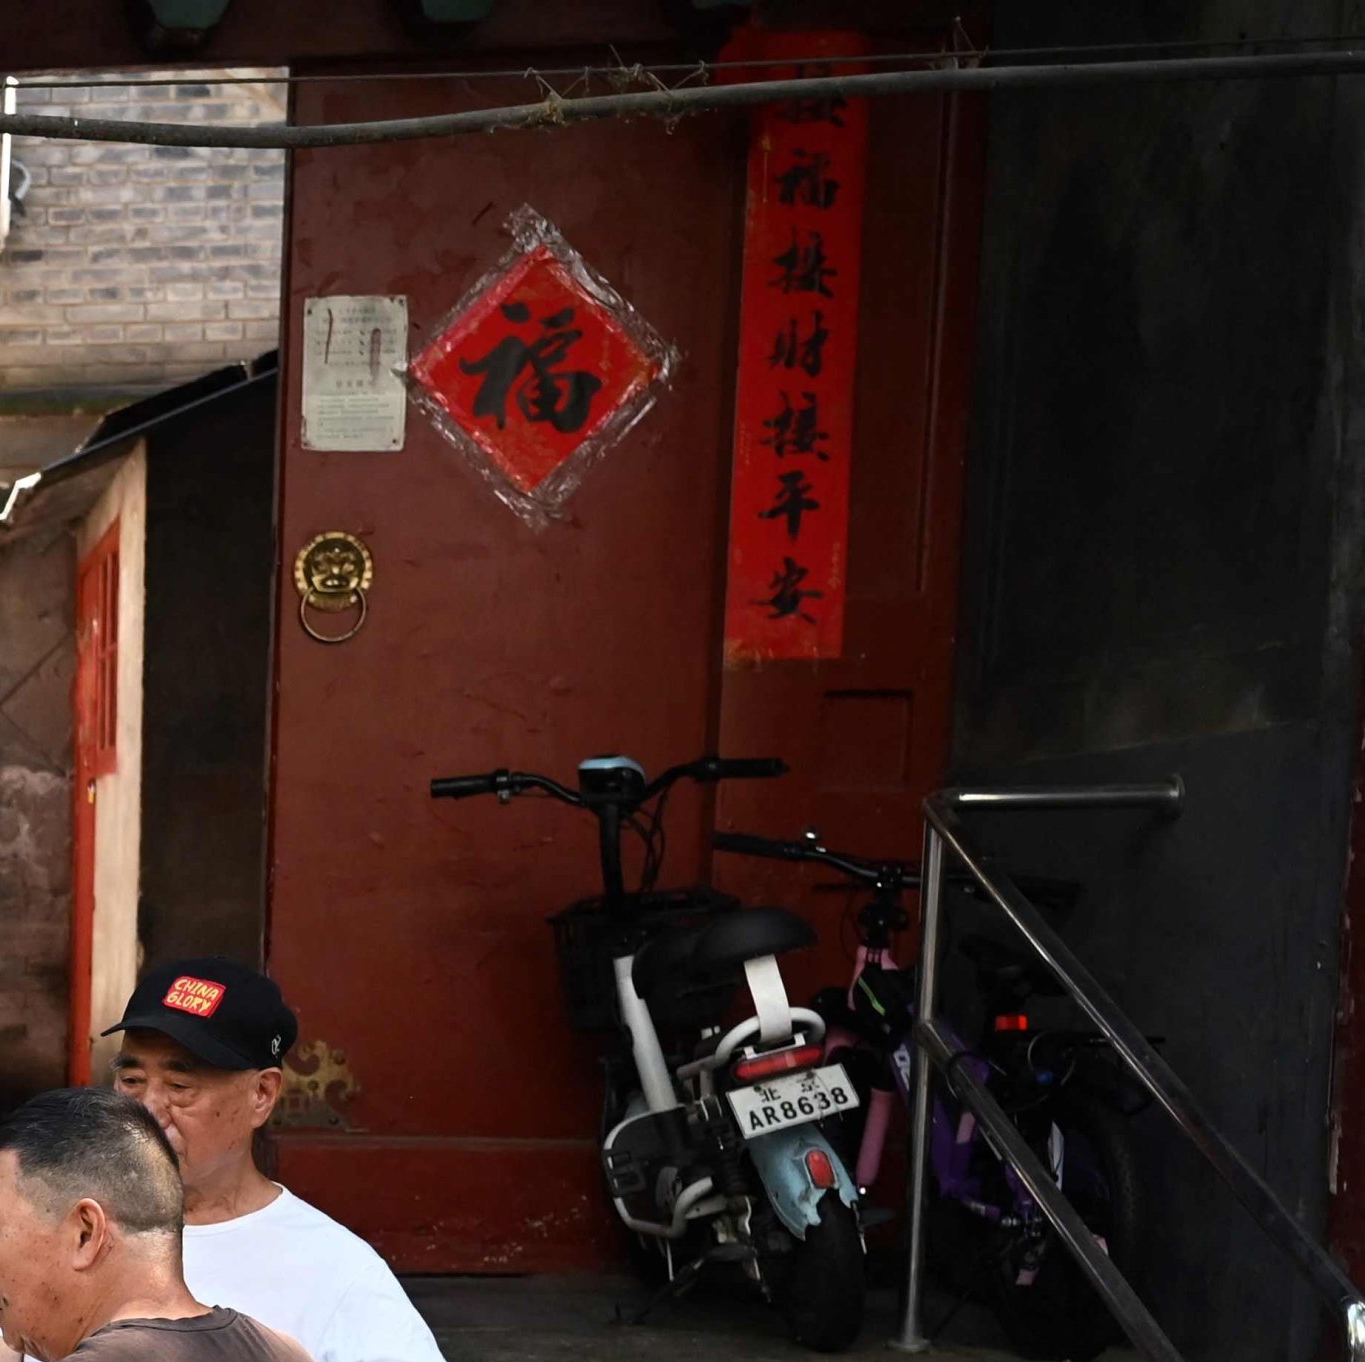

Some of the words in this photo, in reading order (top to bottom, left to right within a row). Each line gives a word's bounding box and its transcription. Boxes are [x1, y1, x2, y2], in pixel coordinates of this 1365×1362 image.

[458, 302, 603, 434] 福
[166, 991, 213, 1014] GLORY
[174, 978, 220, 1001] CHINA
[748, 1086, 849, 1131] AR8638
